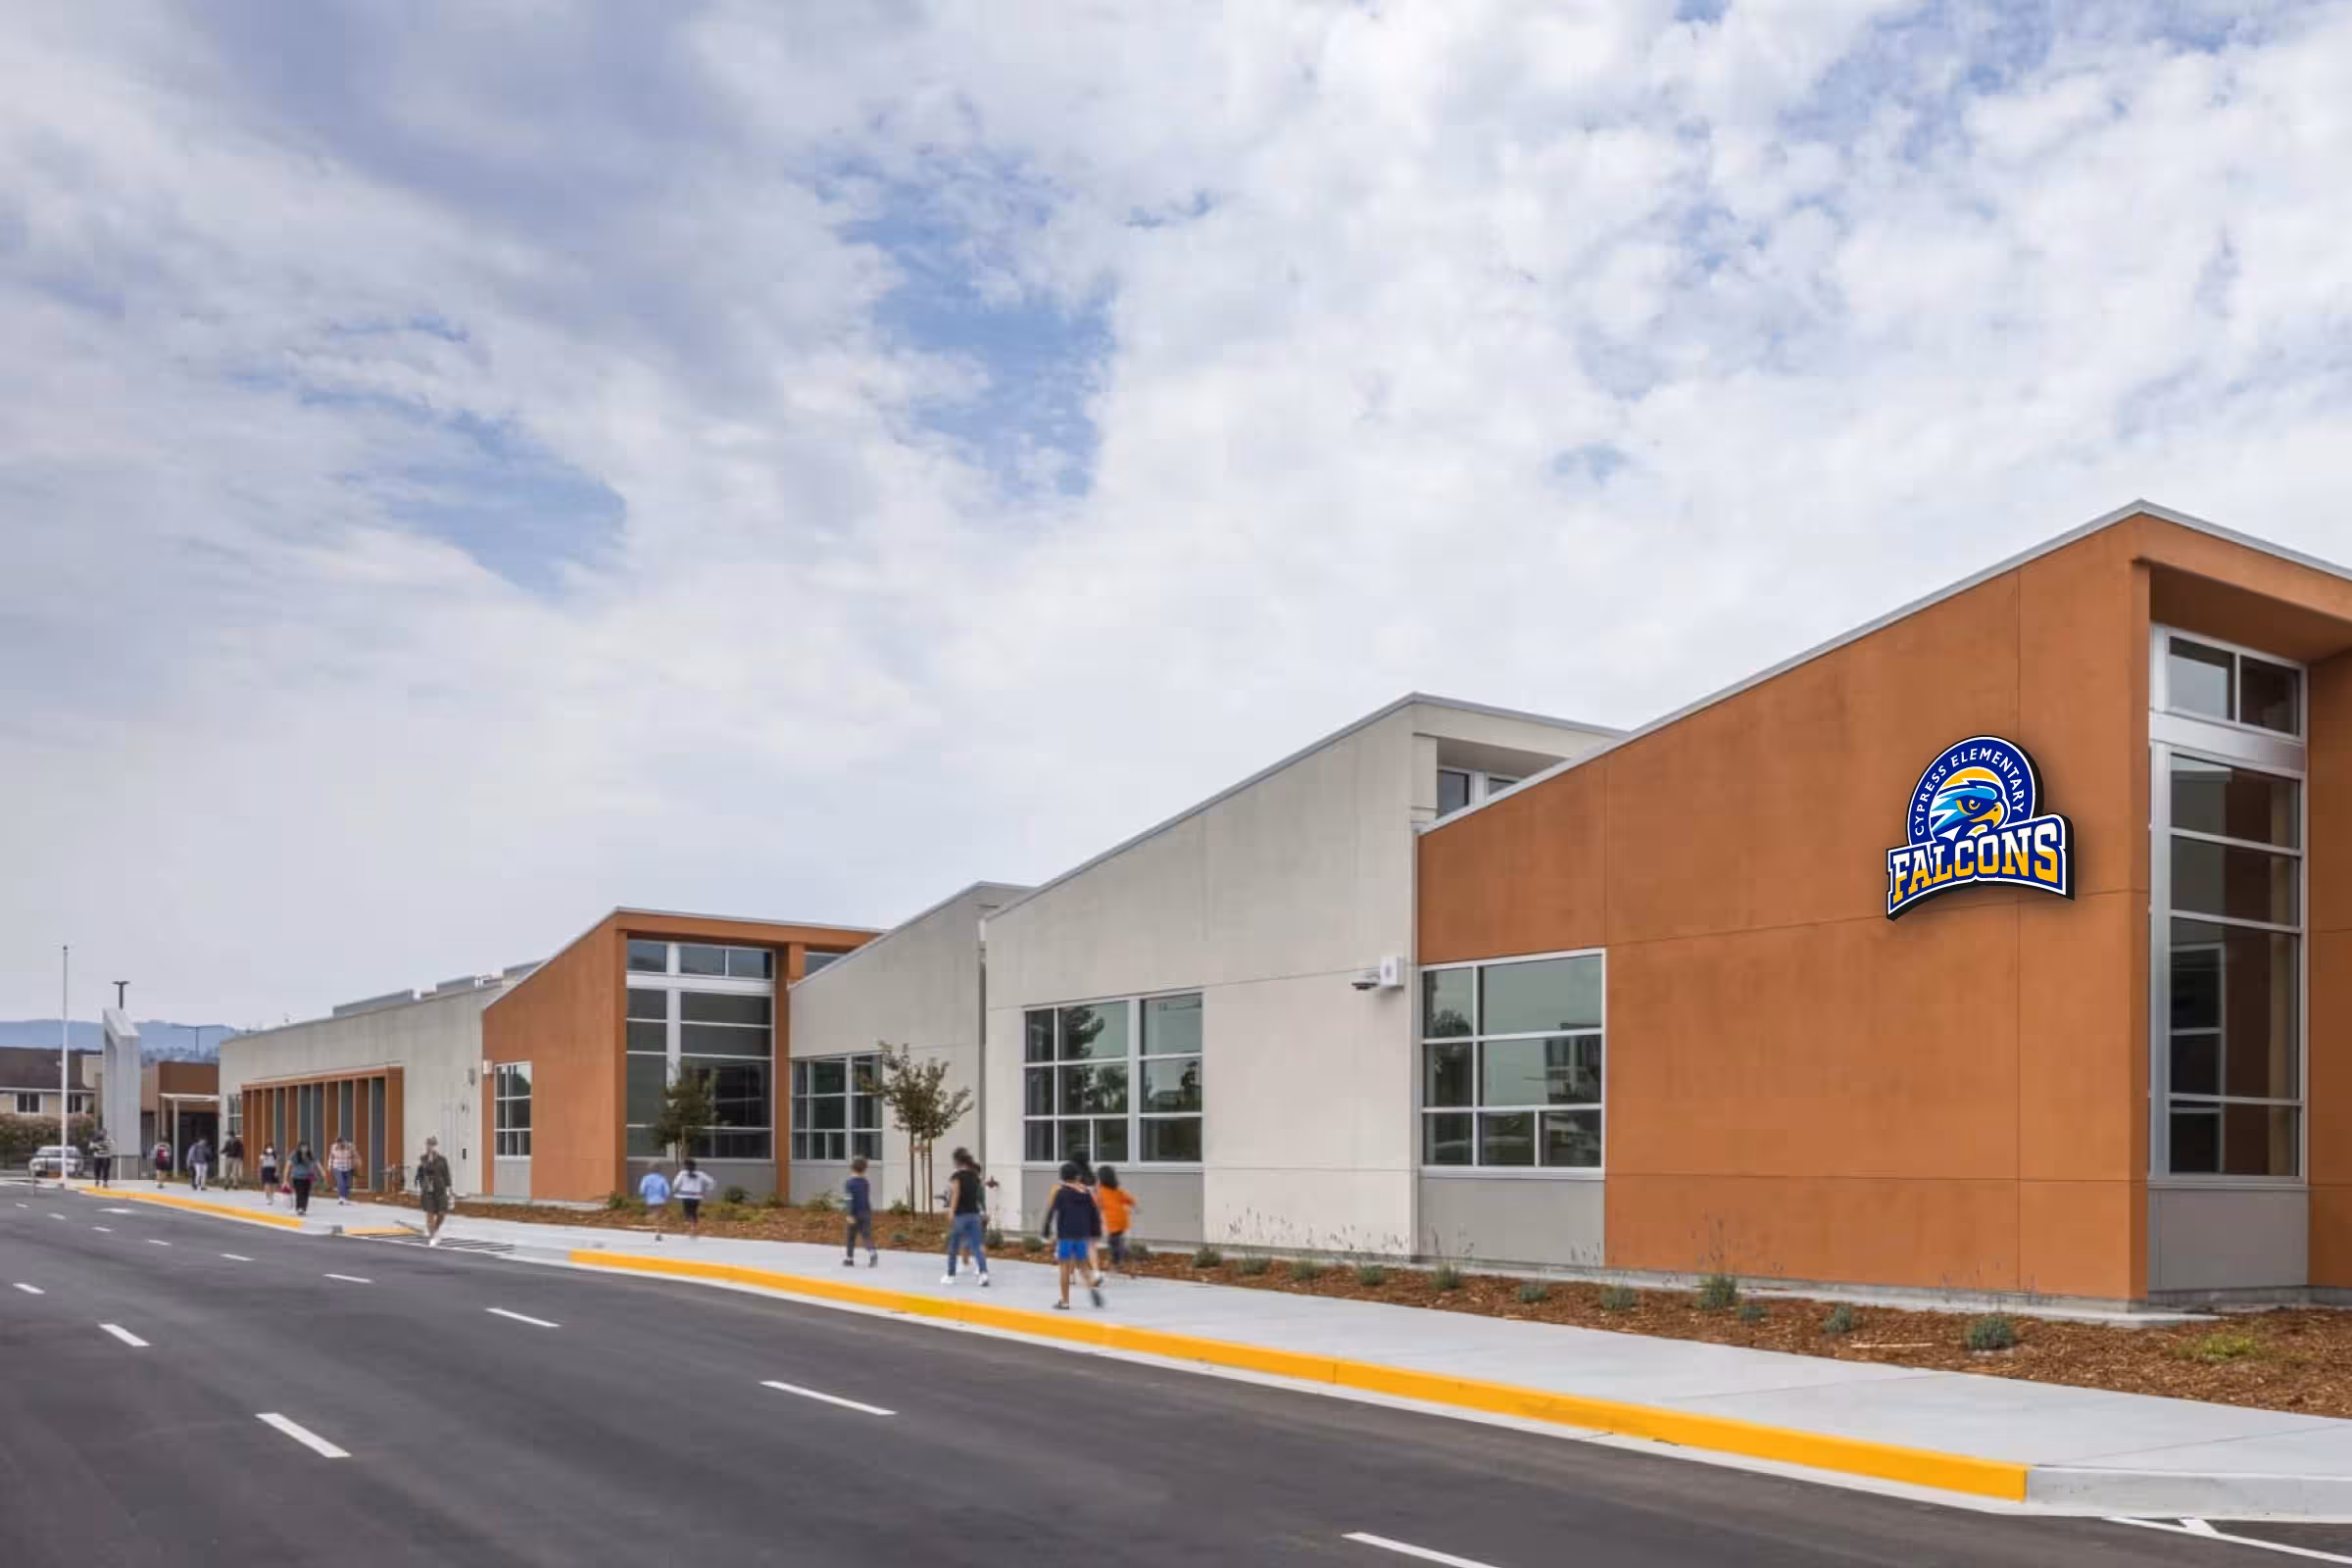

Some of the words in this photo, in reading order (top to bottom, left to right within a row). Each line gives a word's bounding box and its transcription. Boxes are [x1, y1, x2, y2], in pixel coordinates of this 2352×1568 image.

[1914, 765, 1946, 836] CYPRESS
[1950, 748, 2026, 812] ELEMENTARY
[1892, 822, 2058, 905] FALCONS
